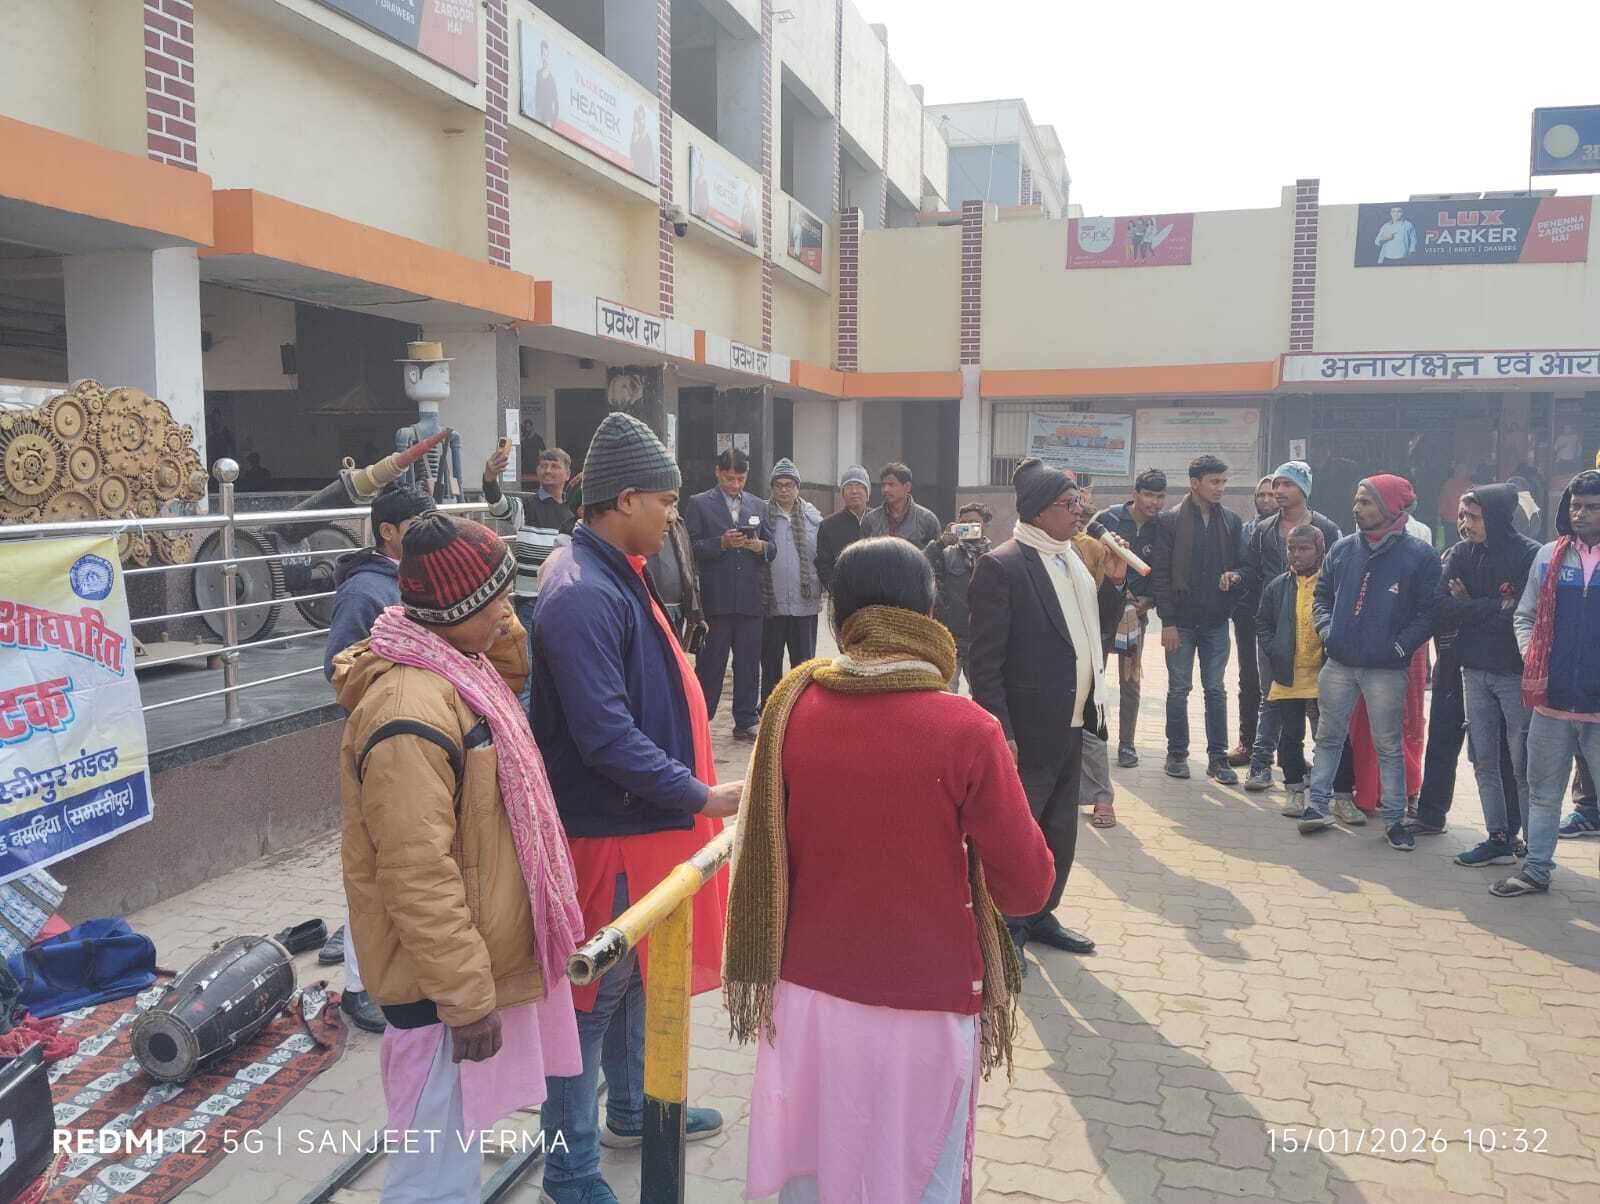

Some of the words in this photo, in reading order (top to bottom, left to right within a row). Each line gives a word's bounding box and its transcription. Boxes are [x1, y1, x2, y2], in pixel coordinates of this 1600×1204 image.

[433, 0, 474, 24] ZAROORI
[447, 18, 464, 35] HAI
[569, 88, 622, 136] HEATEK
[1438, 209, 1505, 227] LUX
[1537, 215, 1585, 234] PEHENNA
[1425, 227, 1518, 245] PARKER
[1537, 223, 1584, 239] ZAROORI
[1495, 352, 1534, 376] एवं
[1539, 353, 1600, 376] आर
[0, 676, 74, 746] टक
[68, 746, 118, 780] मंडल
[63, 782, 134, 834] (समस्तीपुर)
